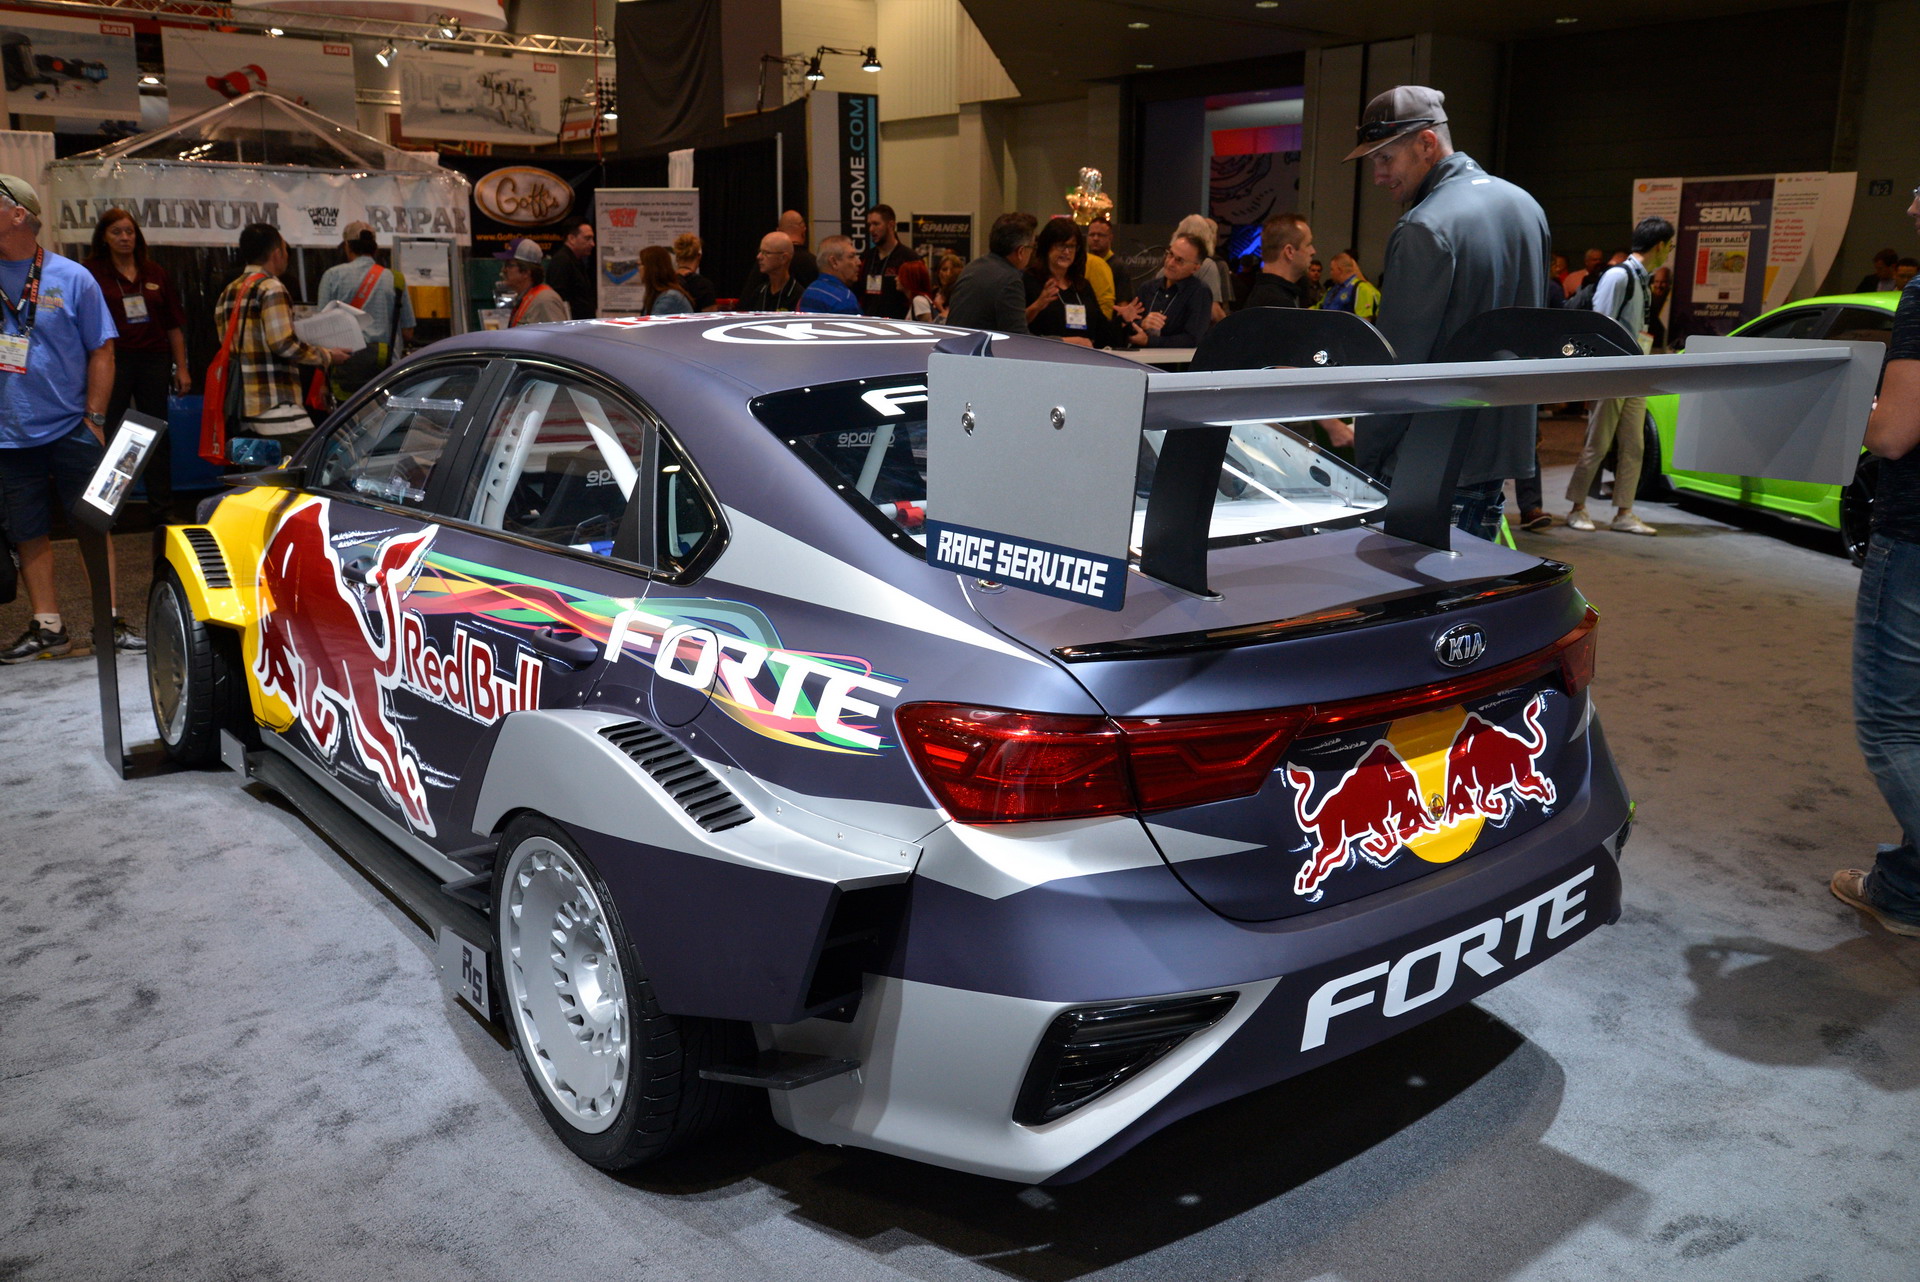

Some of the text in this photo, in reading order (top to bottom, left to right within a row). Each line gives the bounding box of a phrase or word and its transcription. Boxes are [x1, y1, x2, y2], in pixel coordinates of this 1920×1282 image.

[921, 223, 970, 233] SPANESI
[1699, 206, 1753, 224] SEMA
[742, 321, 975, 341] KIA
[837, 431, 896, 449] sparo
[936, 529, 1109, 598] RACE SERVICE
[1448, 631, 1484, 662] KIA
[603, 609, 903, 750] FORTE
[1300, 864, 1596, 1053] FORTE
[462, 944, 483, 1007] RS
